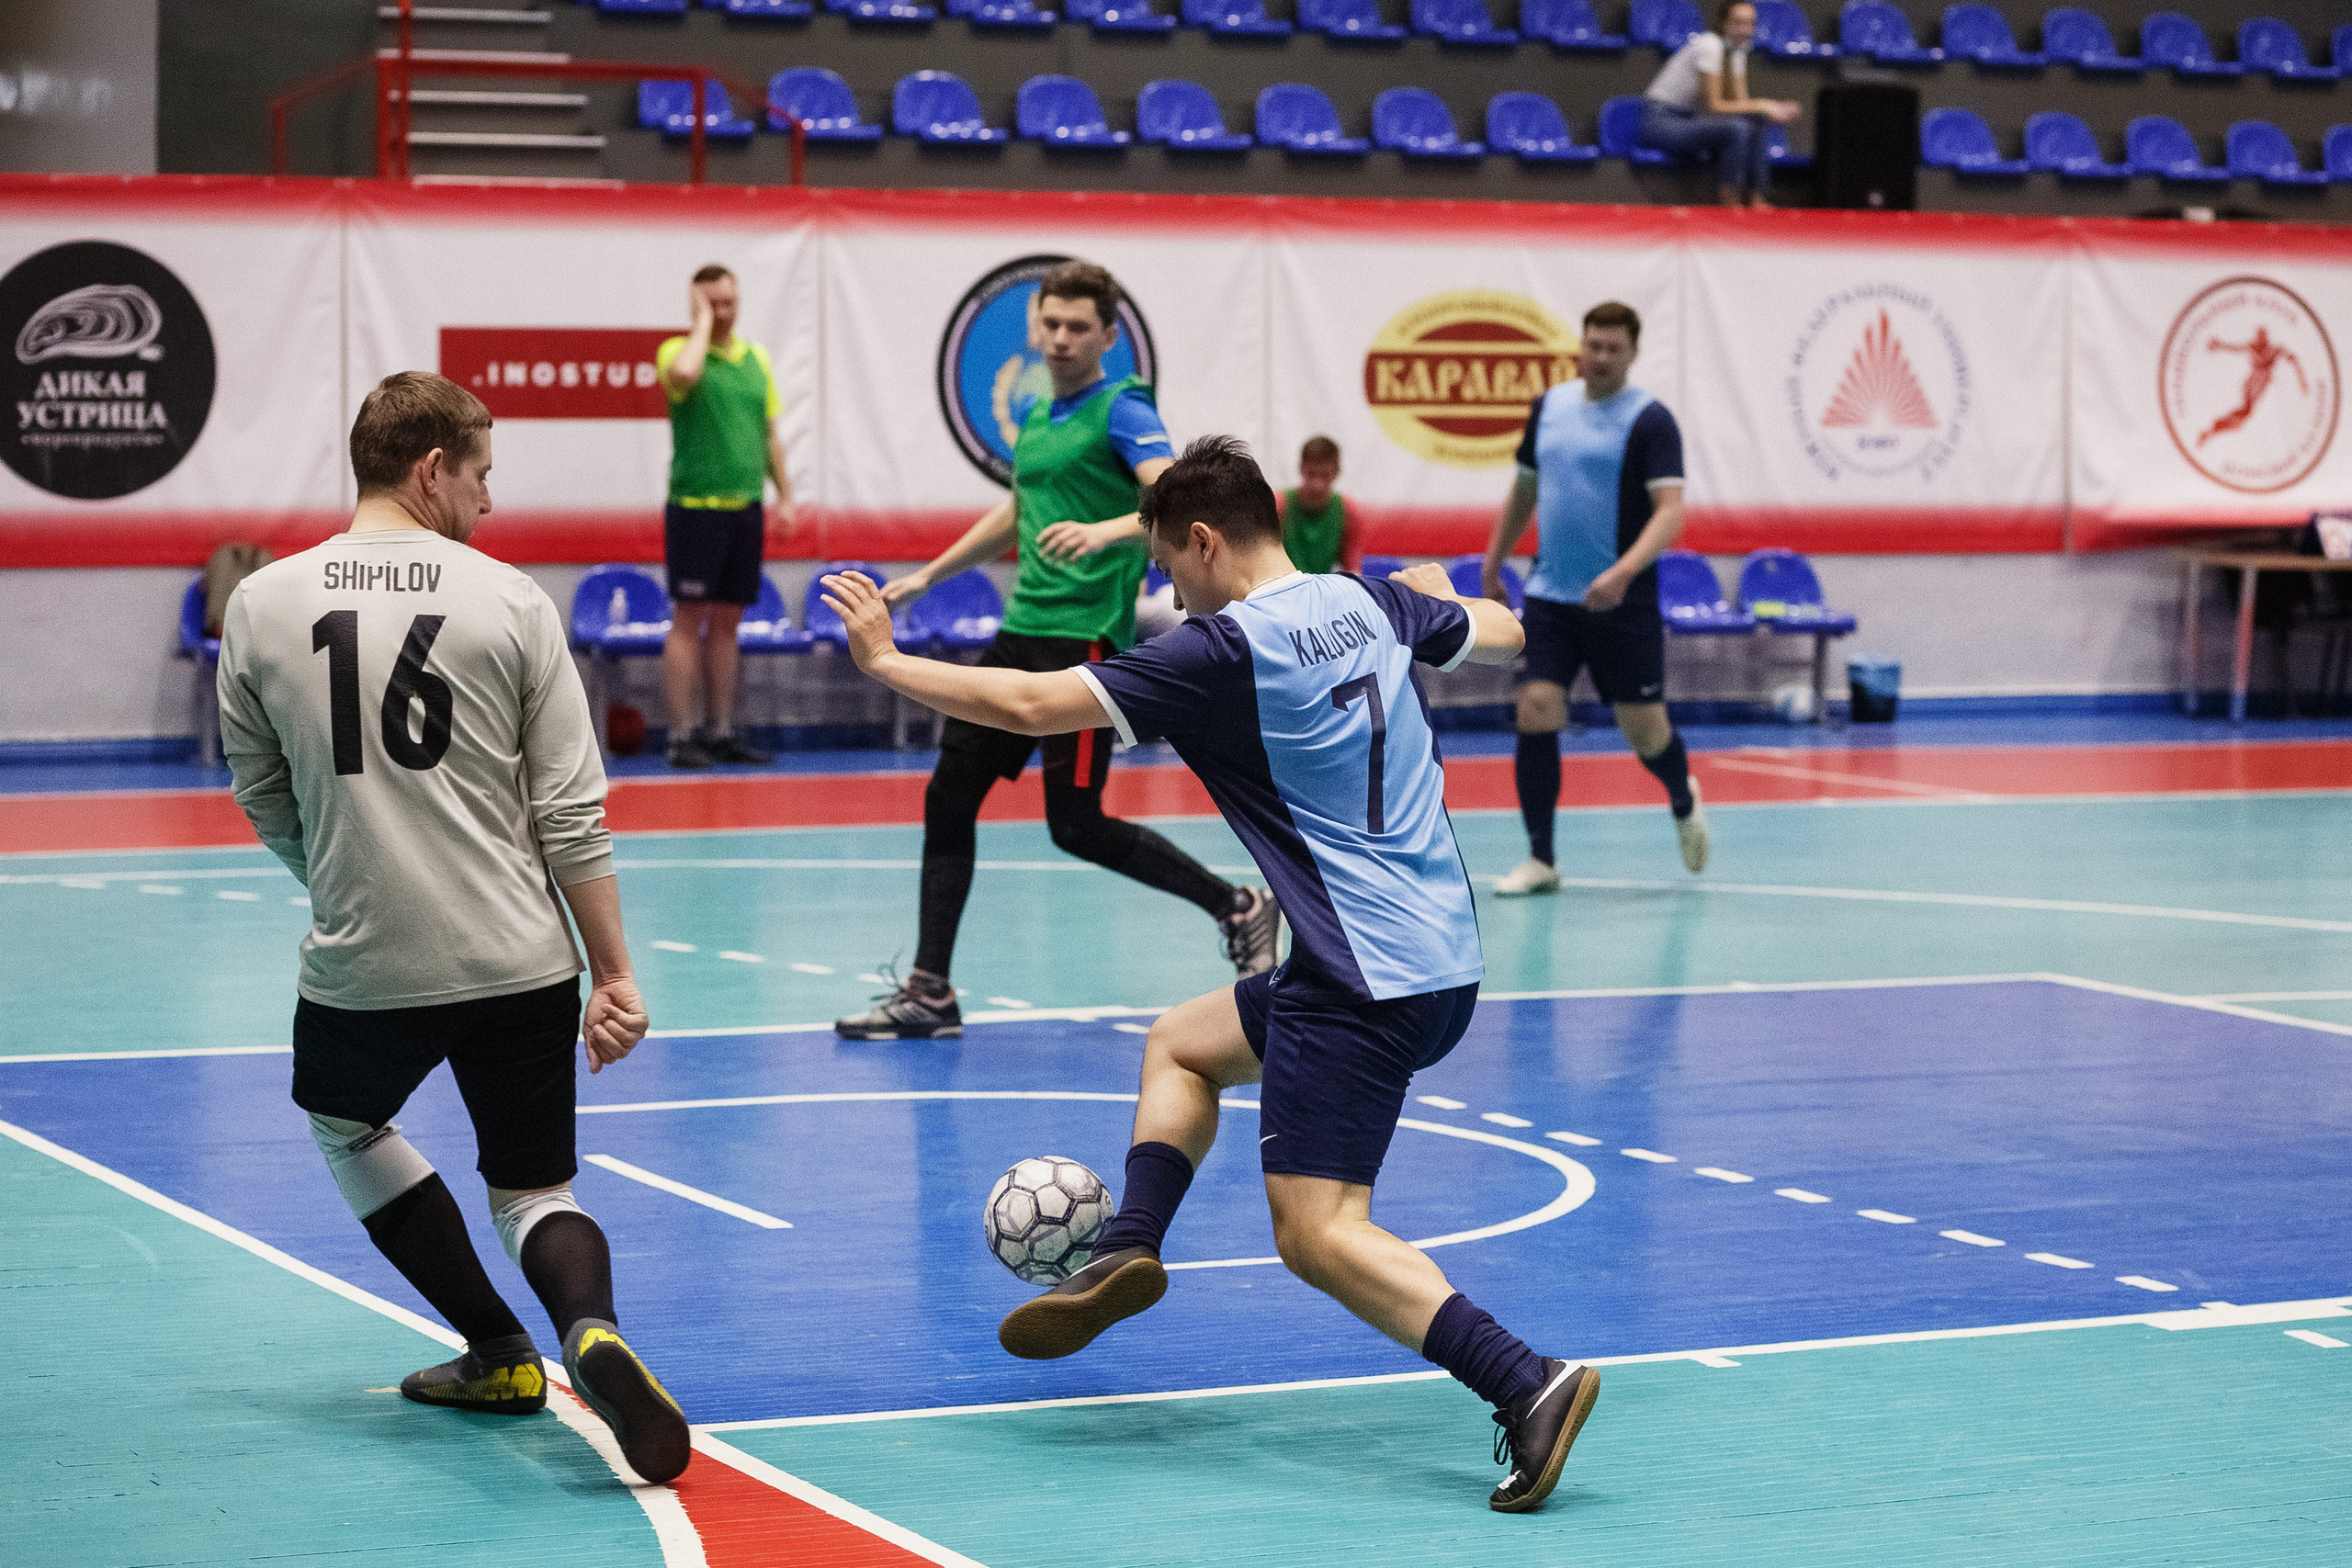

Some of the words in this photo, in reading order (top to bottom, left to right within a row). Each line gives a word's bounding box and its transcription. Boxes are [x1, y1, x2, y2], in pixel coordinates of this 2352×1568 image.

[34, 370, 146, 399] ДИКАЯ
[17, 401, 167, 429] УСТРИЦА
[323, 560, 442, 593] SHIPILOV
[1289, 611, 1377, 668] KALUGIN
[311, 610, 453, 776] 16
[1331, 671, 1387, 835] 7
